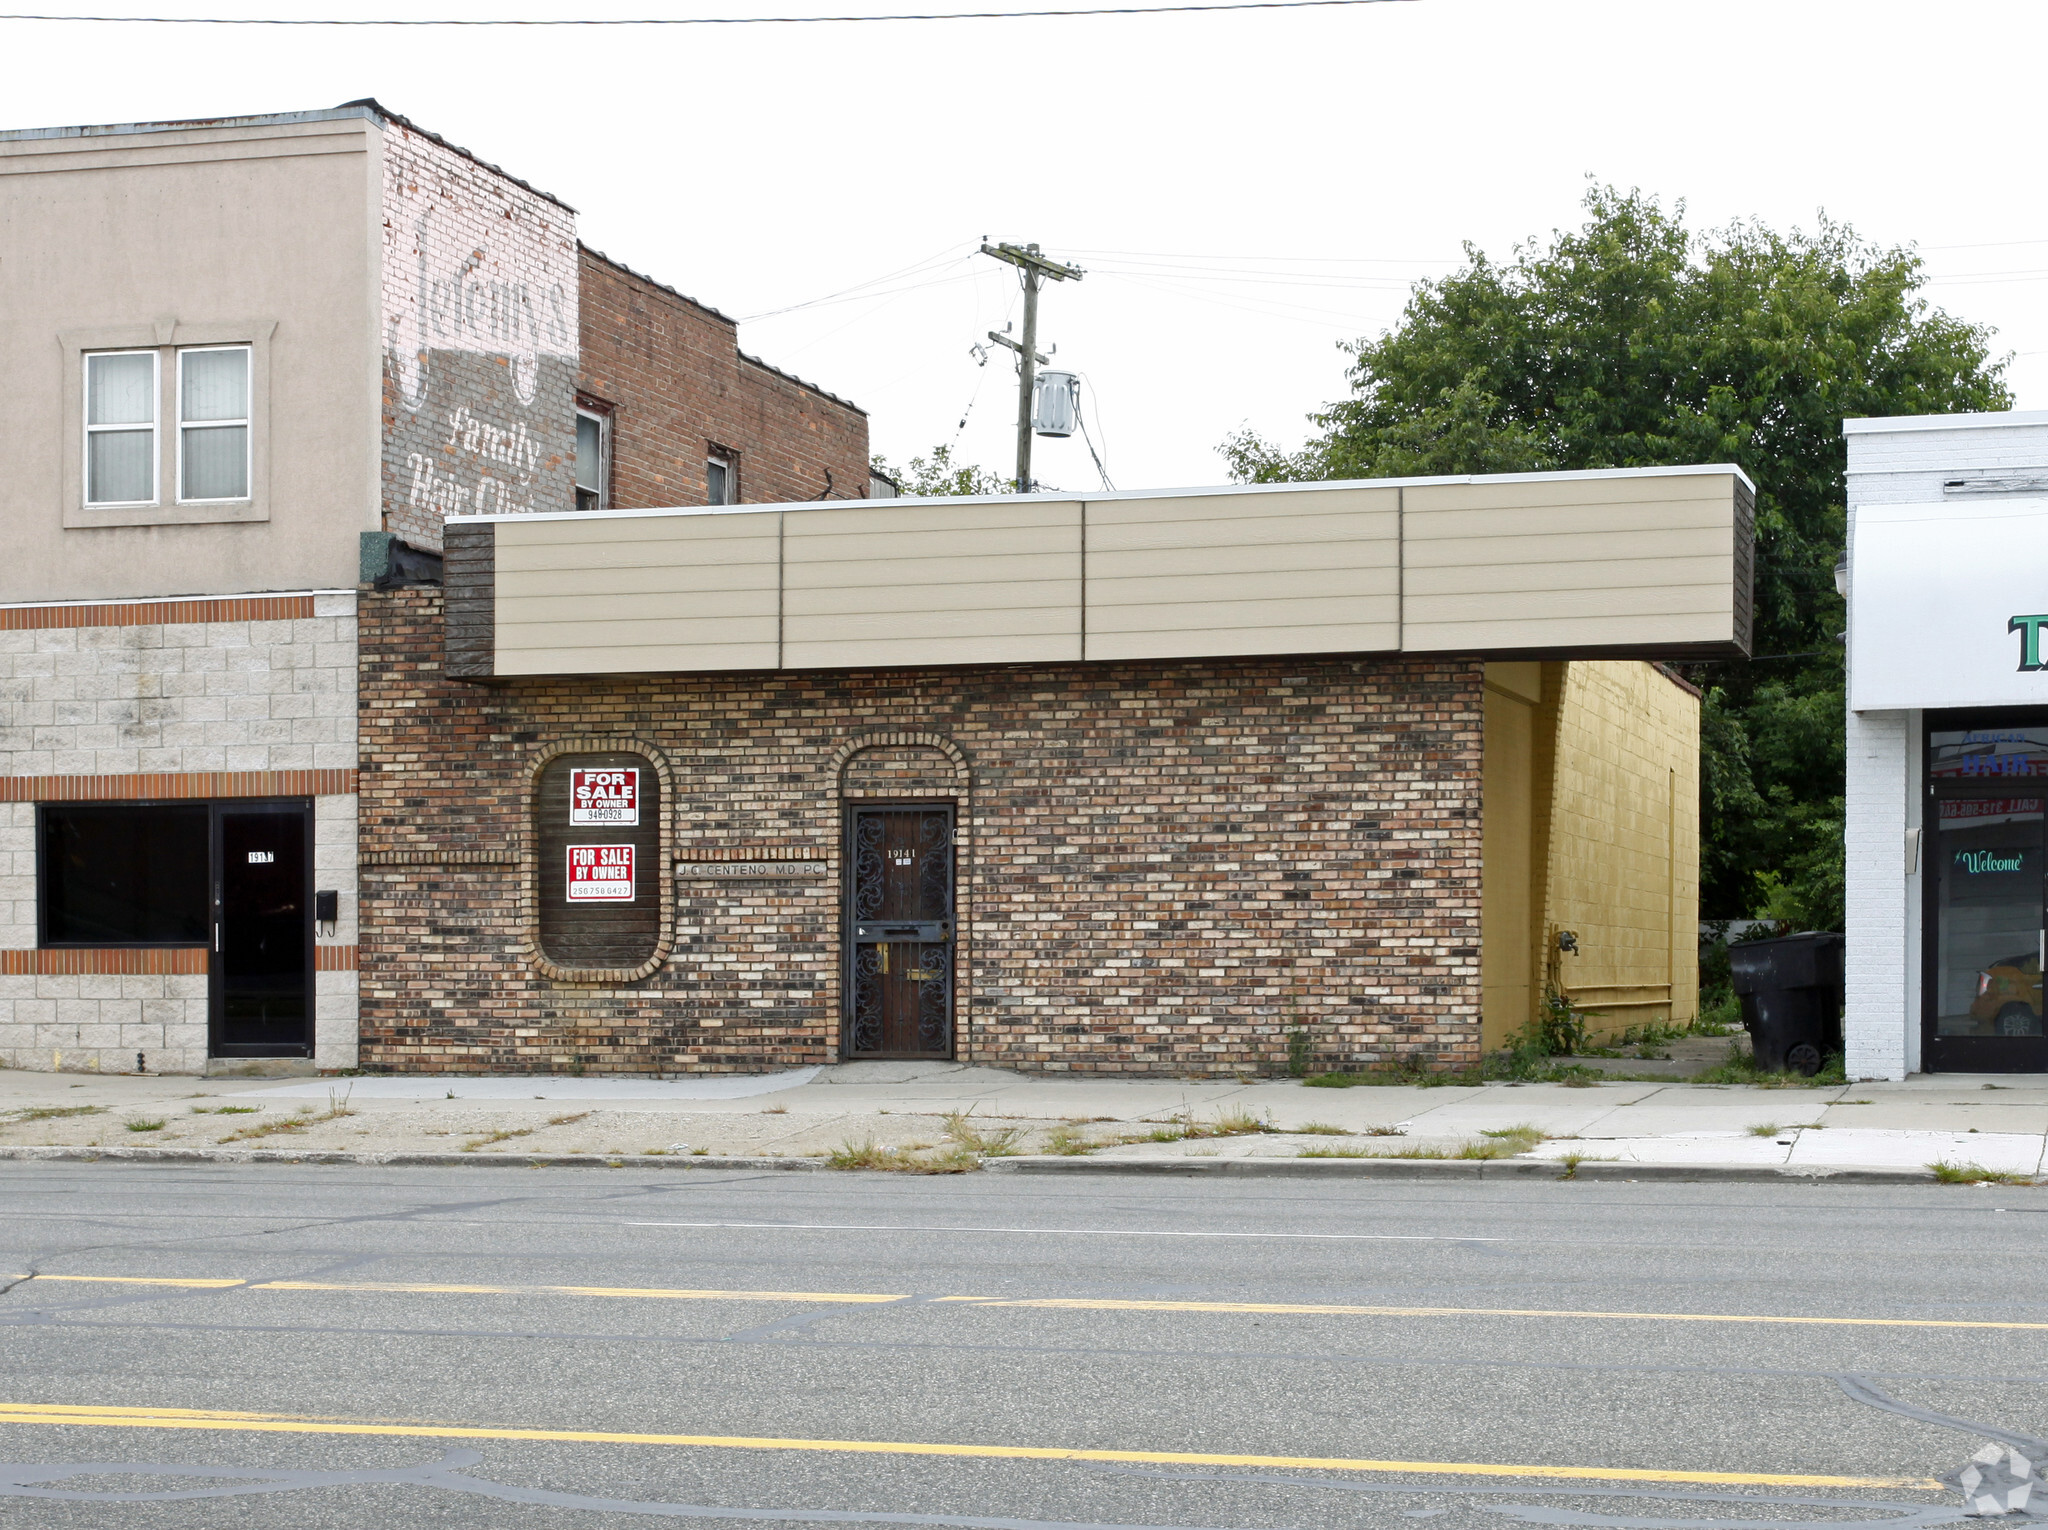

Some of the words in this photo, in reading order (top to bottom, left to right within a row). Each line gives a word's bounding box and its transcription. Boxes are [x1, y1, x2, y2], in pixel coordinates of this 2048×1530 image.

[1962, 733, 2025, 744] AFRICAN
[1962, 754, 2031, 773] HAIR
[584, 773, 626, 786] FOR
[576, 785, 634, 800] SALE
[581, 799, 594, 808] BY
[595, 799, 629, 808] OWNER
[573, 849, 596, 866] FOR
[600, 848, 631, 865] SALE
[887, 849, 915, 858] 19141
[1963, 850, 2021, 874] Welcome
[576, 866, 589, 880] BY
[591, 866, 628, 880] OWNER
